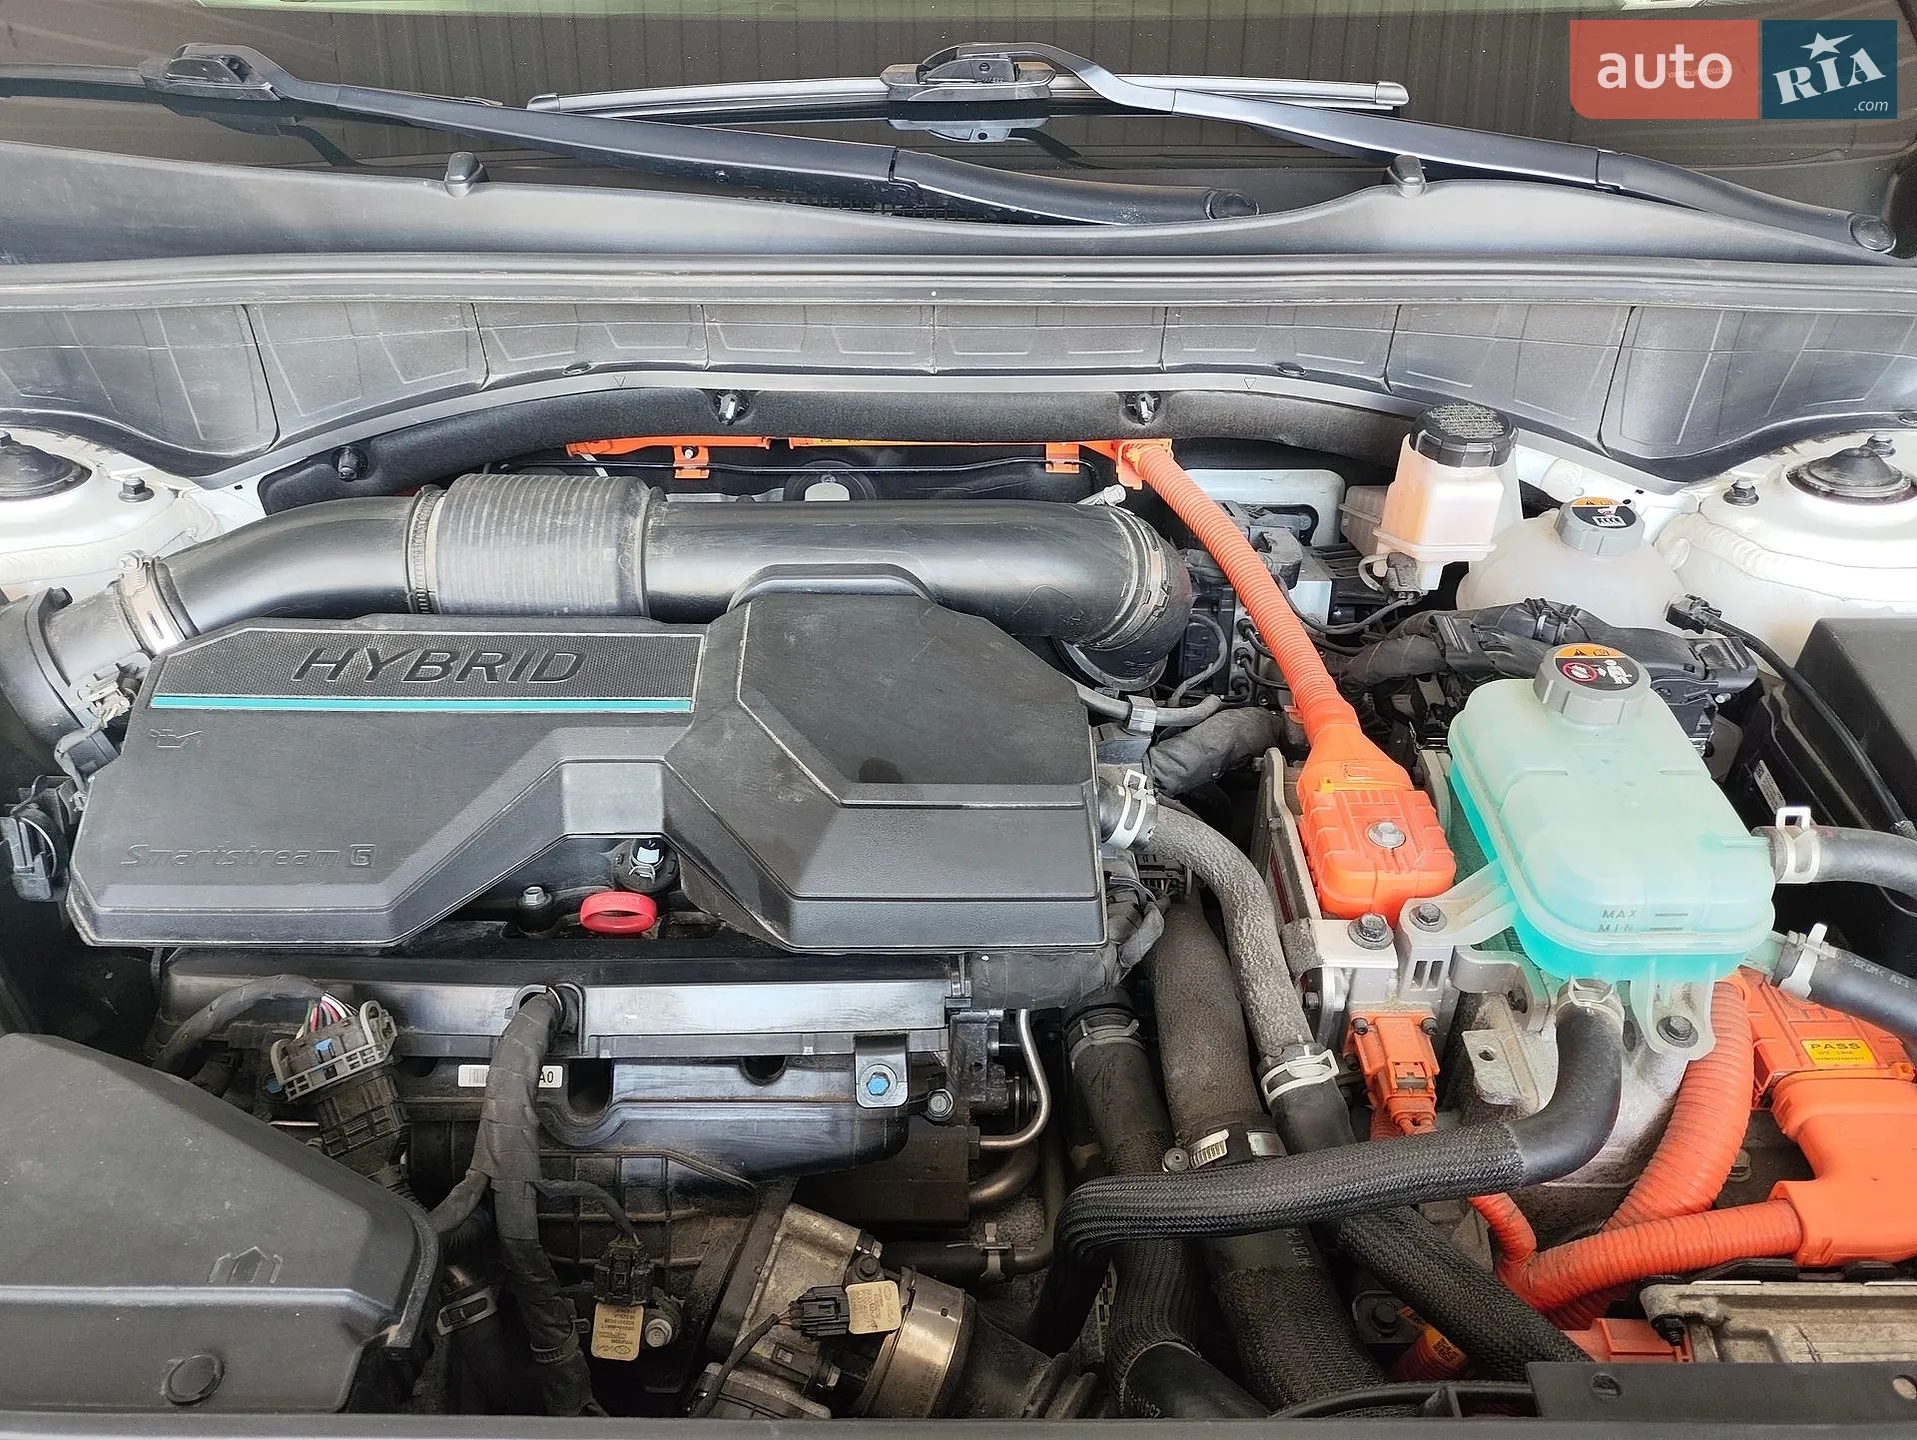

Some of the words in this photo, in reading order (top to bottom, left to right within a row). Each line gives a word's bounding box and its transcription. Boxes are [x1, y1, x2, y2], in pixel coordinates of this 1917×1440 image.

[291, 647, 587, 683] HYBRID
[120, 844, 340, 867] Smartstream
[1602, 909, 1638, 919] MAX
[1598, 923, 1634, 933] MIN
[1811, 1042, 1861, 1050] PASS
